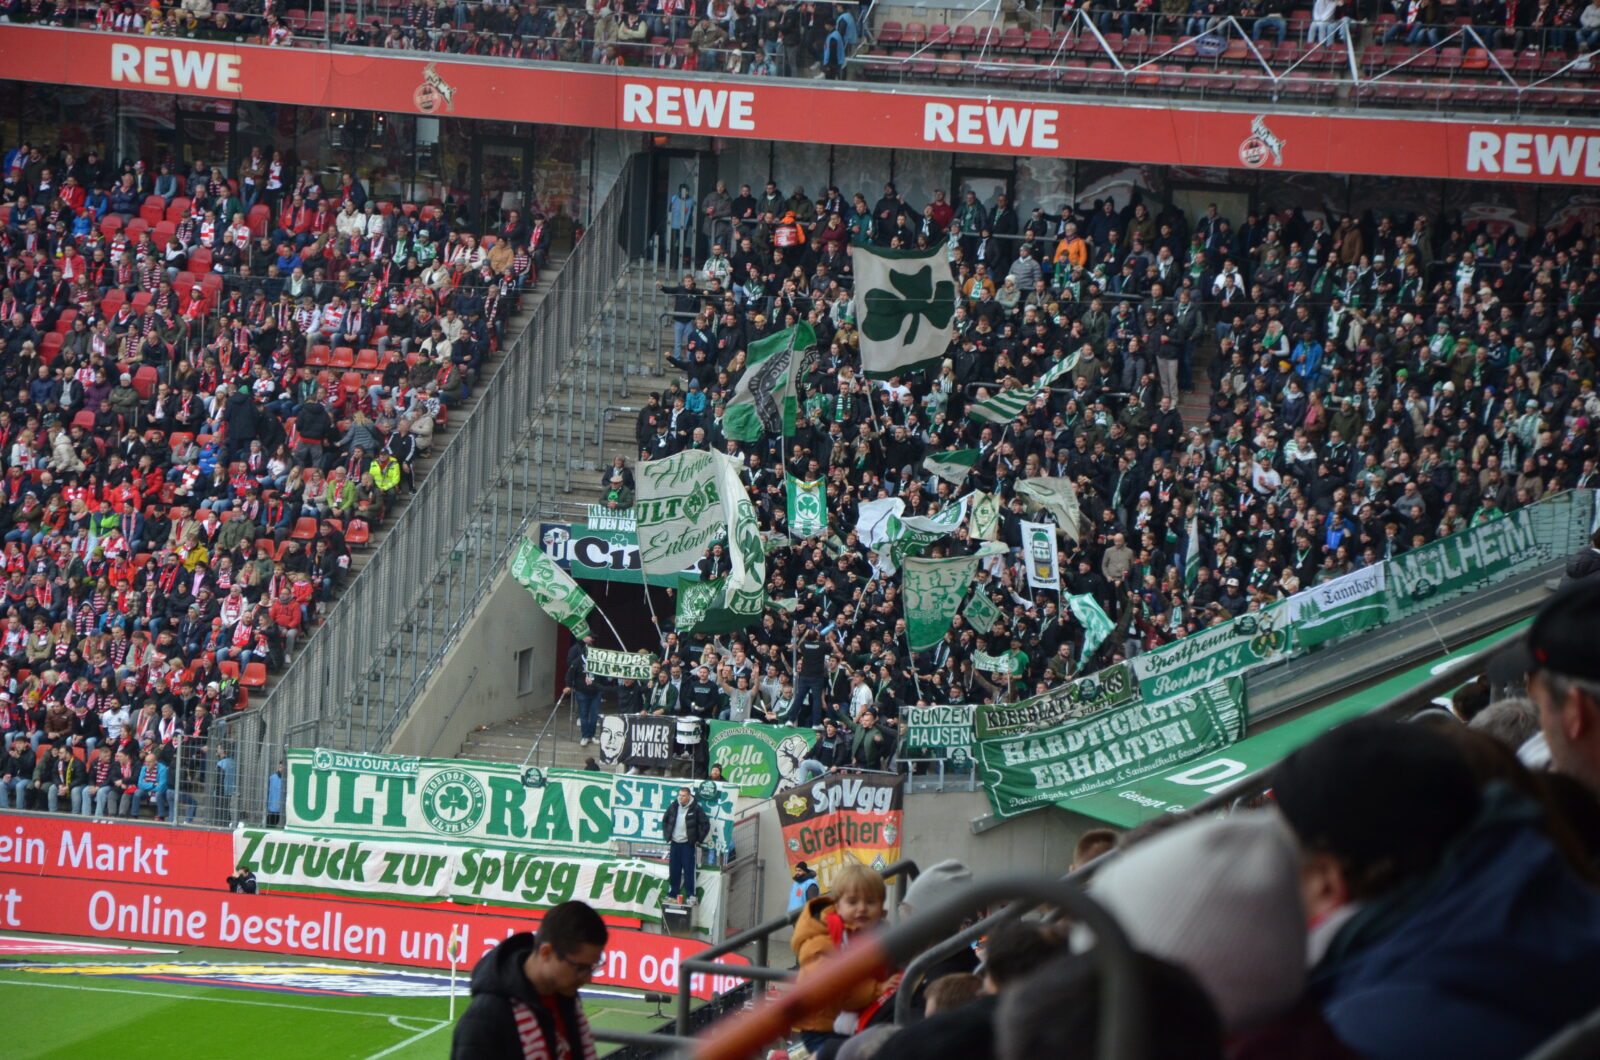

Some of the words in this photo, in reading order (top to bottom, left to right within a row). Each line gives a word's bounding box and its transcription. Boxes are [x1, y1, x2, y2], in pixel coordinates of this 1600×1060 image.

[111, 43, 242, 93] REWE
[623, 83, 755, 131] REWE
[923, 102, 1060, 149] REWE
[588, 518, 598, 529] IN
[599, 519, 617, 530] DEN
[618, 520, 637, 532] USA
[586, 647, 650, 667] HORIDOS
[1145, 628, 1241, 673] Sportfreund
[1153, 660, 1216, 697] Ronhof
[631, 724, 670, 743] IMMER
[910, 707, 971, 726] GUNZEN
[1000, 692, 1198, 767] HARDTICKETS
[631, 742, 646, 758] BEI
[647, 742, 669, 760] UNS
[716, 744, 764, 767] Bella
[909, 728, 972, 747] HAUSEN
[1029, 719, 1197, 790] ERHALTEN!
[335, 755, 419, 774] ENTOURAGE
[727, 767, 772, 787] Ciao
[425, 772, 465, 796] HORIDOS
[467, 778, 483, 799] 1000
[811, 779, 894, 816] SpVgg
[431, 815, 475, 833] ULTRAS
[799, 815, 883, 855] Grether
[57, 830, 169, 876] Markt
[235, 829, 373, 883] Zurück
[377, 851, 448, 888] zur
[453, 848, 581, 905] SpVgg
[589, 861, 705, 912] Für
[88, 889, 207, 940] Online
[219, 901, 387, 957] bestellen
[400, 924, 471, 965] und
